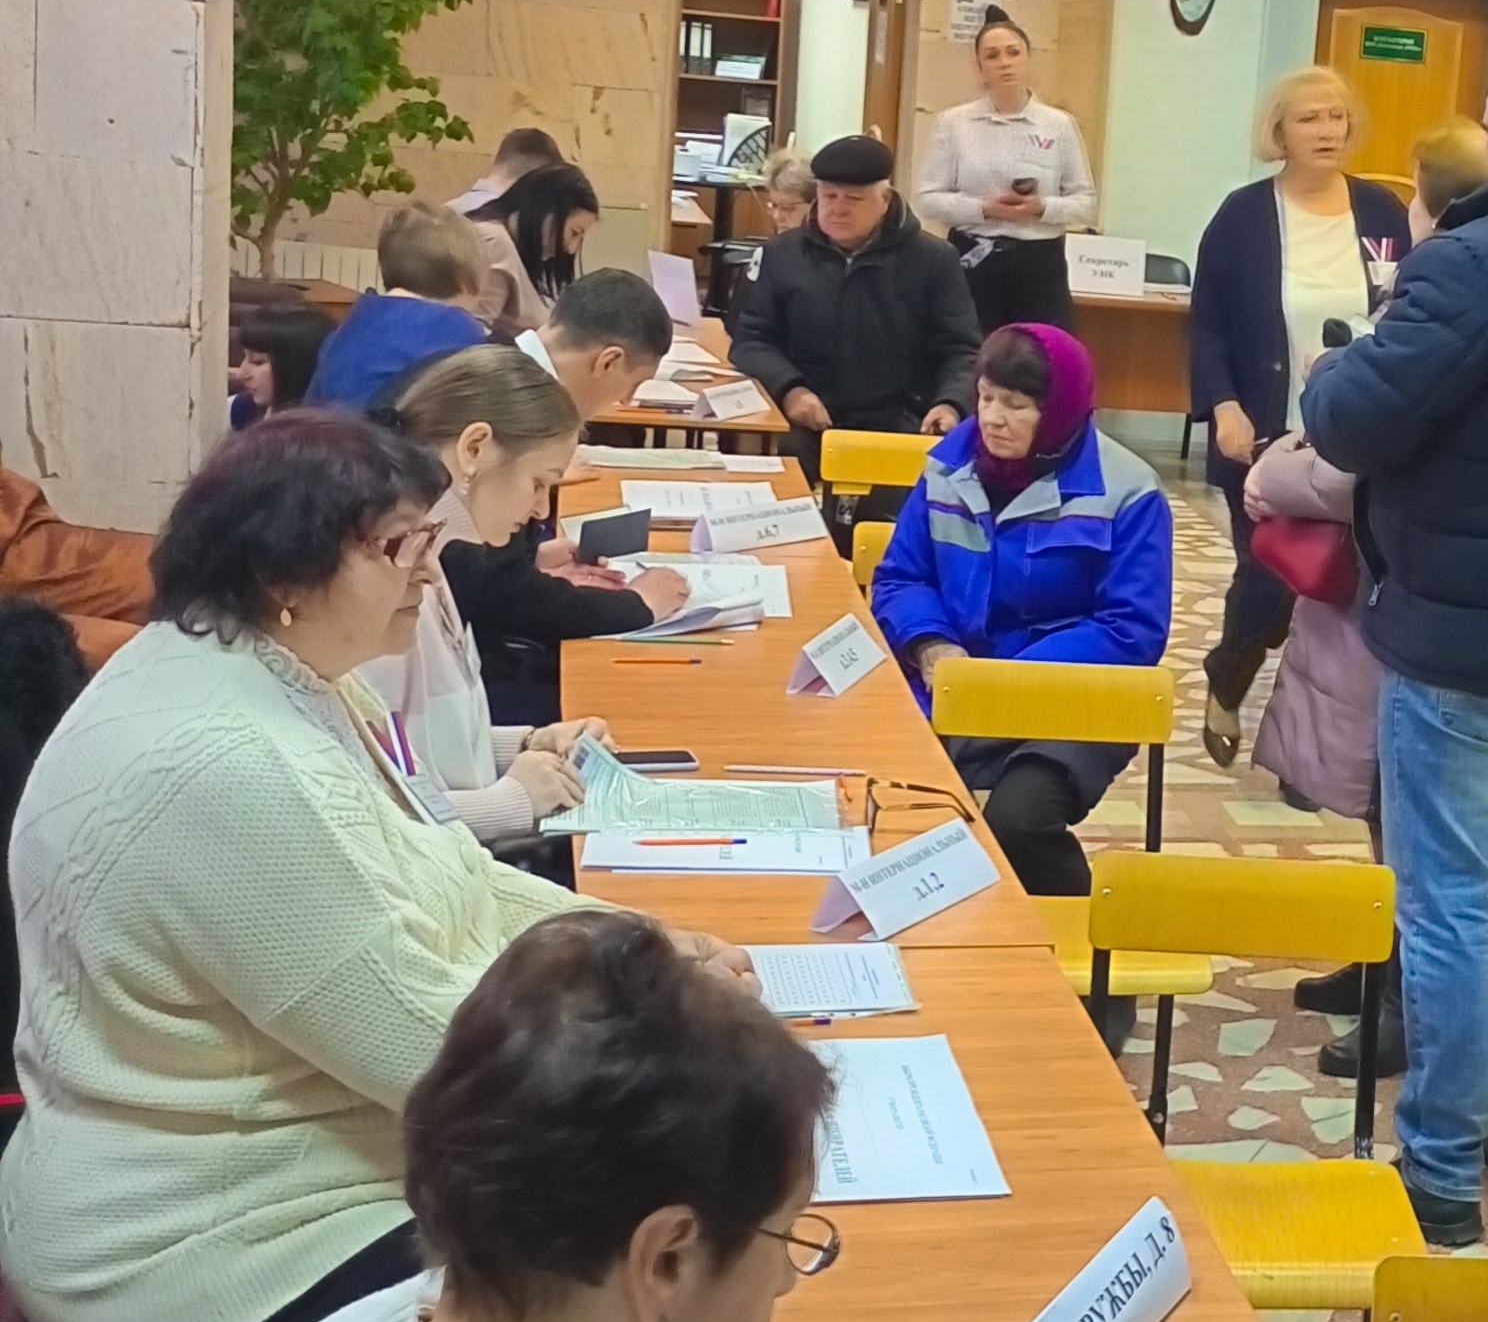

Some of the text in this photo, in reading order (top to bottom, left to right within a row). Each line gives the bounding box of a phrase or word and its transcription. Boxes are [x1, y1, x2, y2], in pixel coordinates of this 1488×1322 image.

[1079, 255, 1129, 268] Секретарь
[868, 828, 968, 887] ИНТЕРНАЦИОНАЛЬНЫЙ
[1144, 1232, 1167, 1268] Д.
[1160, 1216, 1176, 1244] 8
